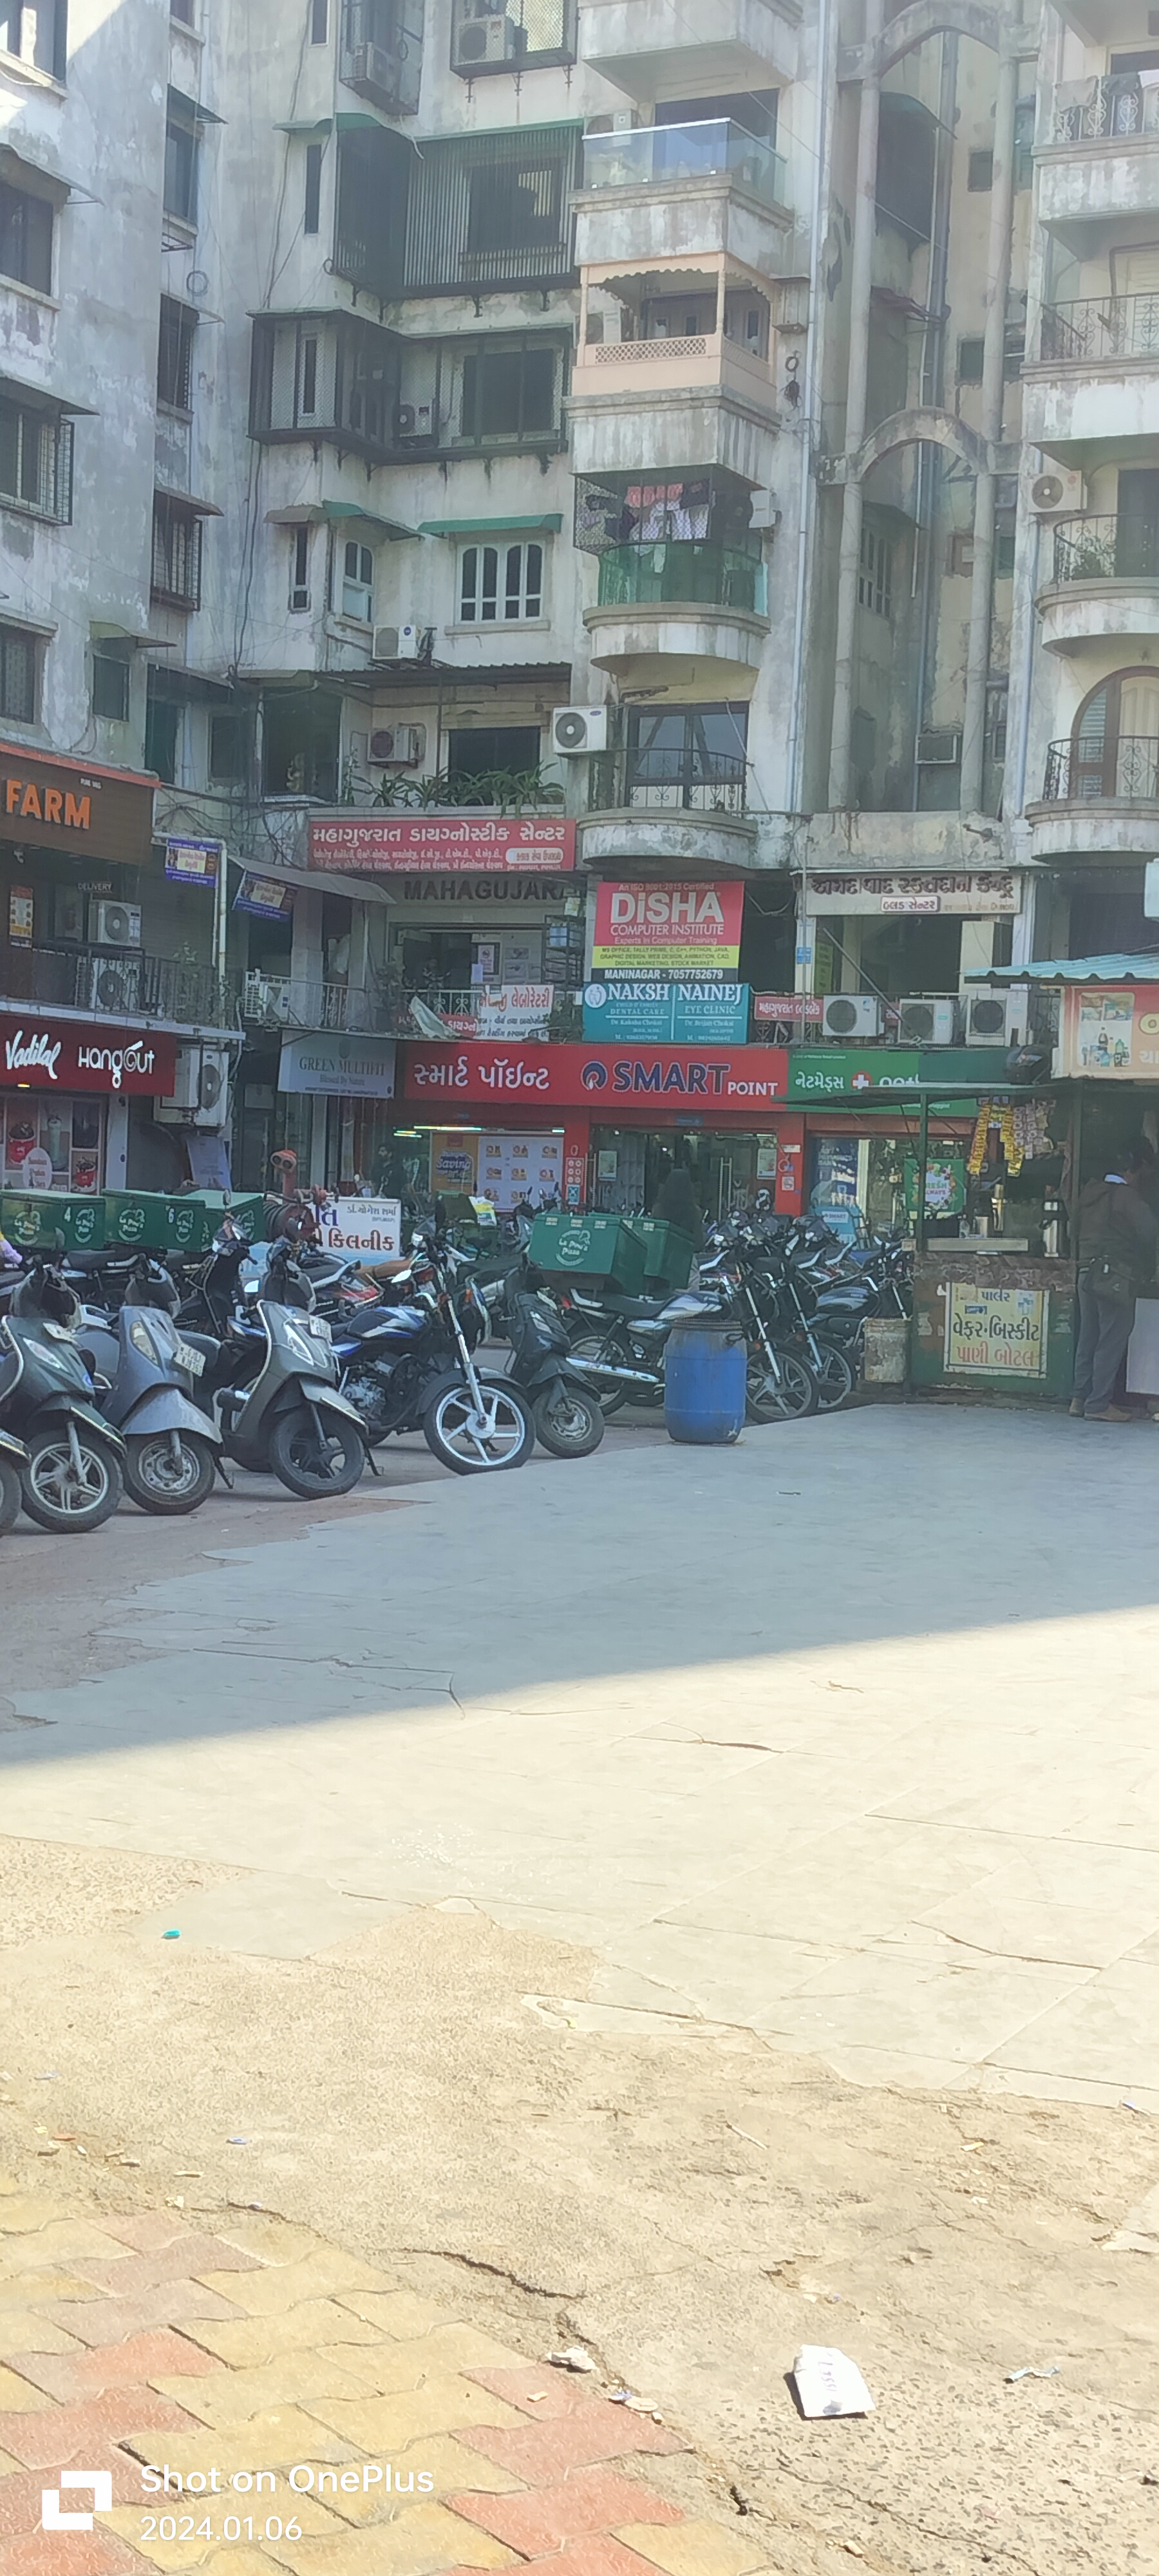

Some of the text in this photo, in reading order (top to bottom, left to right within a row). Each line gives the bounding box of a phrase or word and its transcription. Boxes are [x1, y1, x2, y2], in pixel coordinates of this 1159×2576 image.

[6, 779, 91, 829] FARM
[313, 821, 565, 847] મહાગુજરાત ડાયગ્નોસ્ટીક સેન્ટર
[610, 924, 724, 936] COMPUTER INSTITUTE
[615, 936, 641, 945] Experts
[652, 936, 686, 945] Computer
[688, 936, 717, 945] Training
[604, 969, 660, 979] MANINAGAR
[668, 969, 723, 979] 7057752679
[608, 983, 669, 1001] NAKSH
[677, 983, 742, 1005] NAINEJ
[685, 1005, 735, 1014] EYE CLINIC
[5, 1030, 61, 1079] Vadilal
[299, 1057, 335, 1071] GREEN
[414, 1056, 469, 1086] સ્માર્ટ
[613, 1061, 778, 1096] SMART POINT
[795, 1072, 843, 1093] નેટમેડ્સ
[64, 1206, 71, 1222] 4
[168, 1208, 174, 1224] 6
[957, 1341, 1034, 1366] પાણી બોટલ
